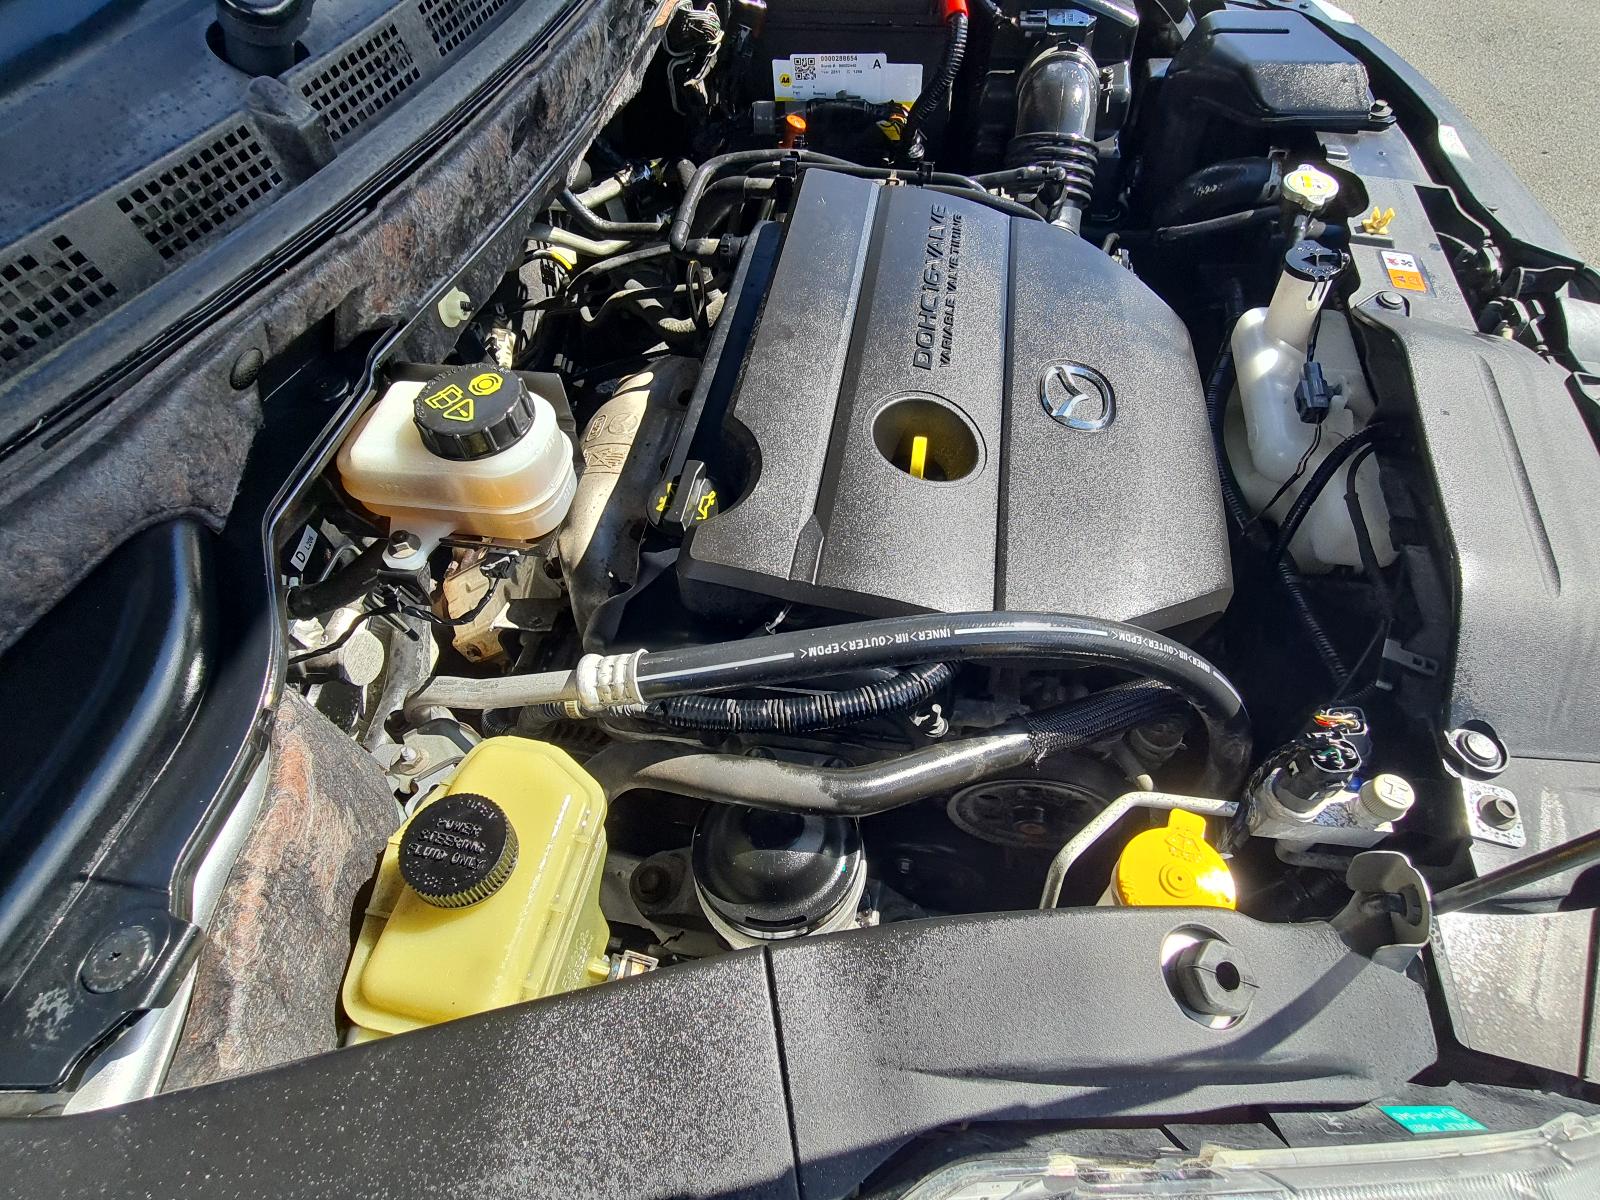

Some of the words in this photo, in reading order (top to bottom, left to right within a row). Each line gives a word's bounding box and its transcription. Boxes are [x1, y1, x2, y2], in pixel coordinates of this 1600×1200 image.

[873, 58, 882, 69] A
[950, 213, 963, 255] TIMING
[946, 256, 960, 295] VALVE
[912, 293, 939, 371] DOHC
[939, 296, 955, 368] VARIABLE
[295, 551, 306, 563] D
[436, 817, 483, 837] POWER
[420, 829, 487, 854] STEERING
[451, 851, 487, 871] ONLY
